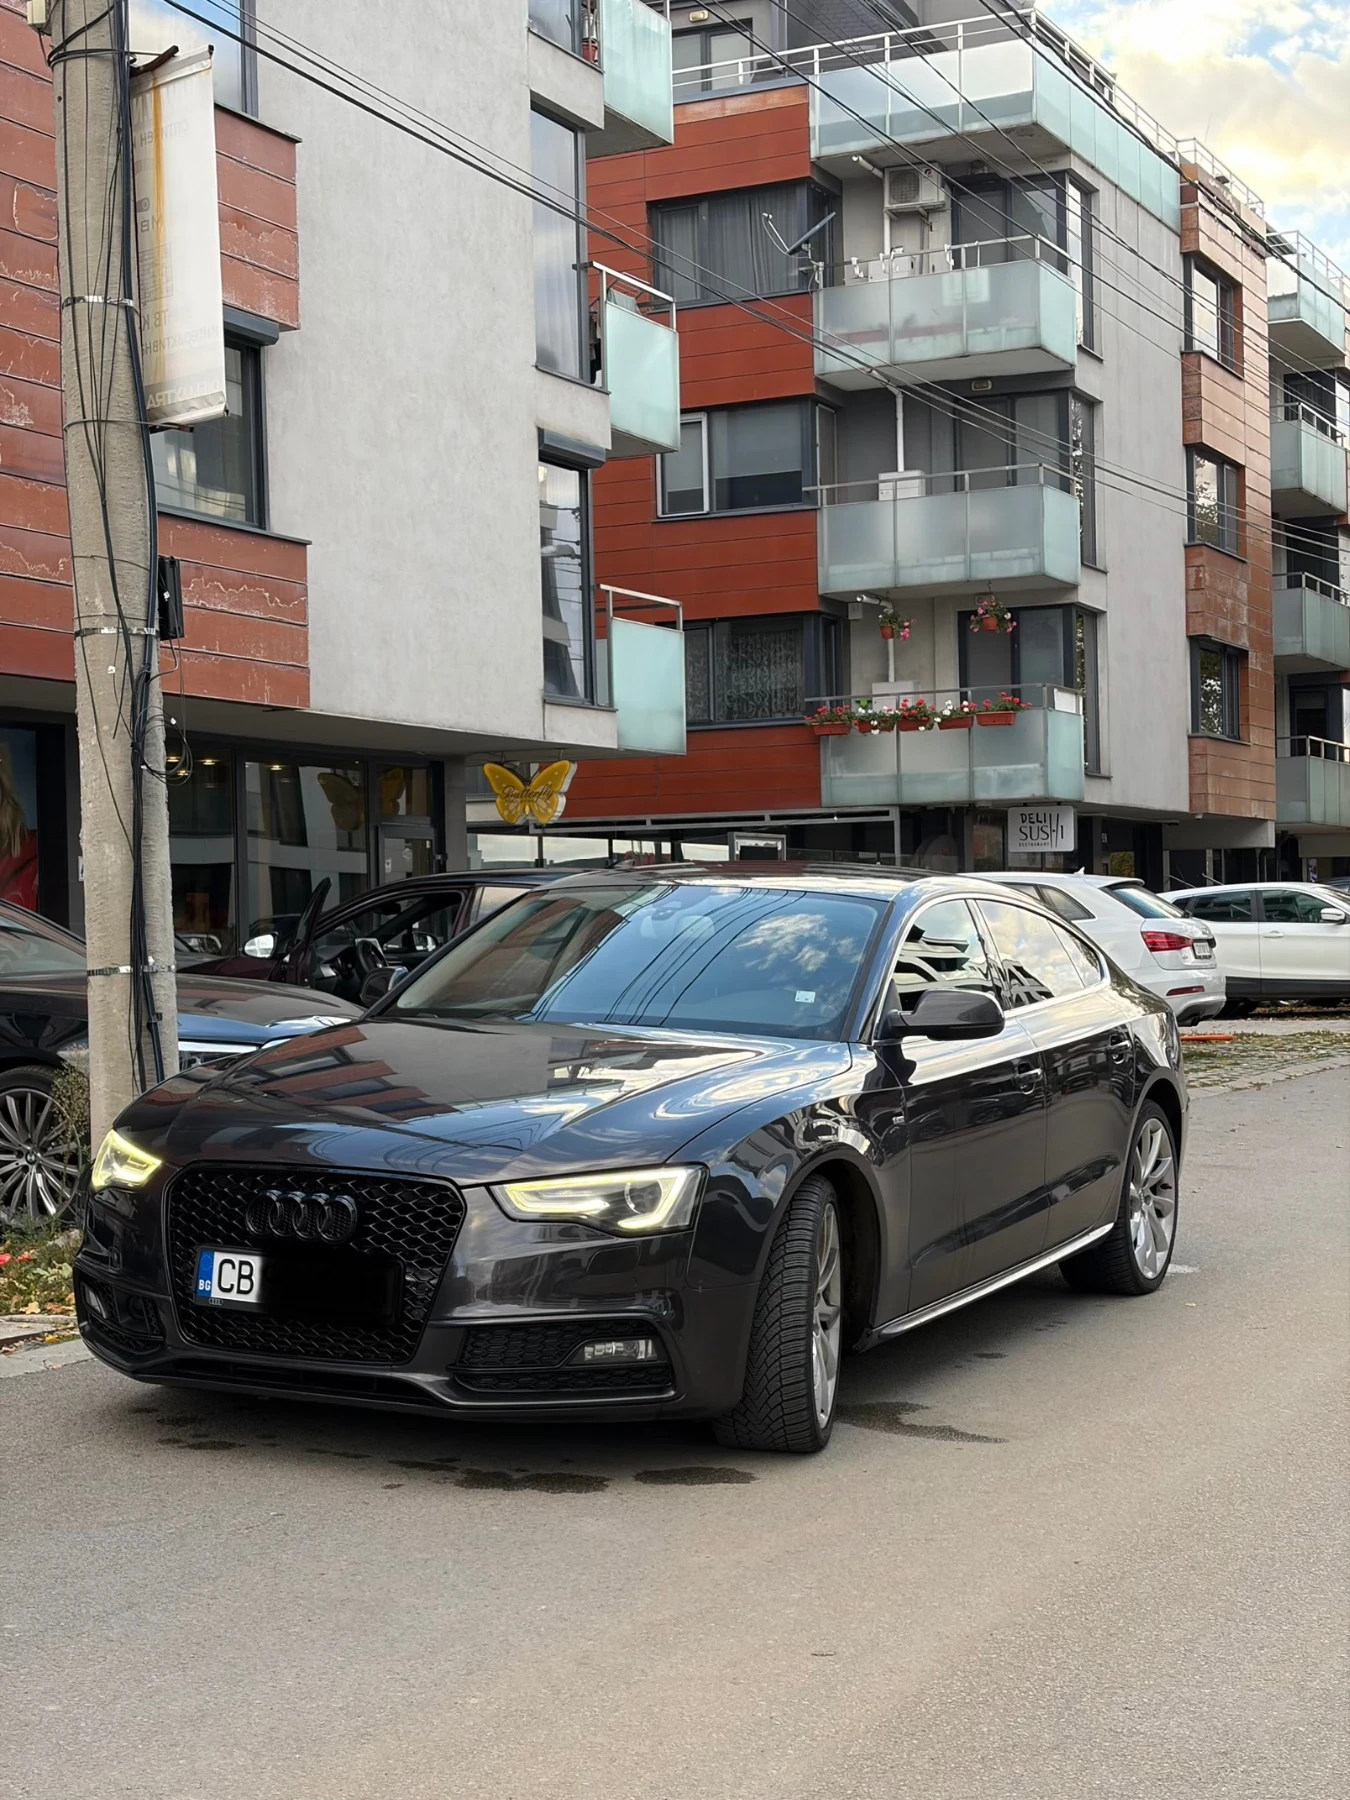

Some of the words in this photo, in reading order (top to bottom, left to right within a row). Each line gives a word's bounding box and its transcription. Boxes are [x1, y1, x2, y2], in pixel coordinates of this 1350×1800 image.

[502, 784, 554, 803] Butterfly
[1020, 812, 1047, 824] DELI
[1019, 813, 1064, 848] SUSHI
[198, 1279, 211, 1291] BG
[217, 1258, 254, 1295] CB
